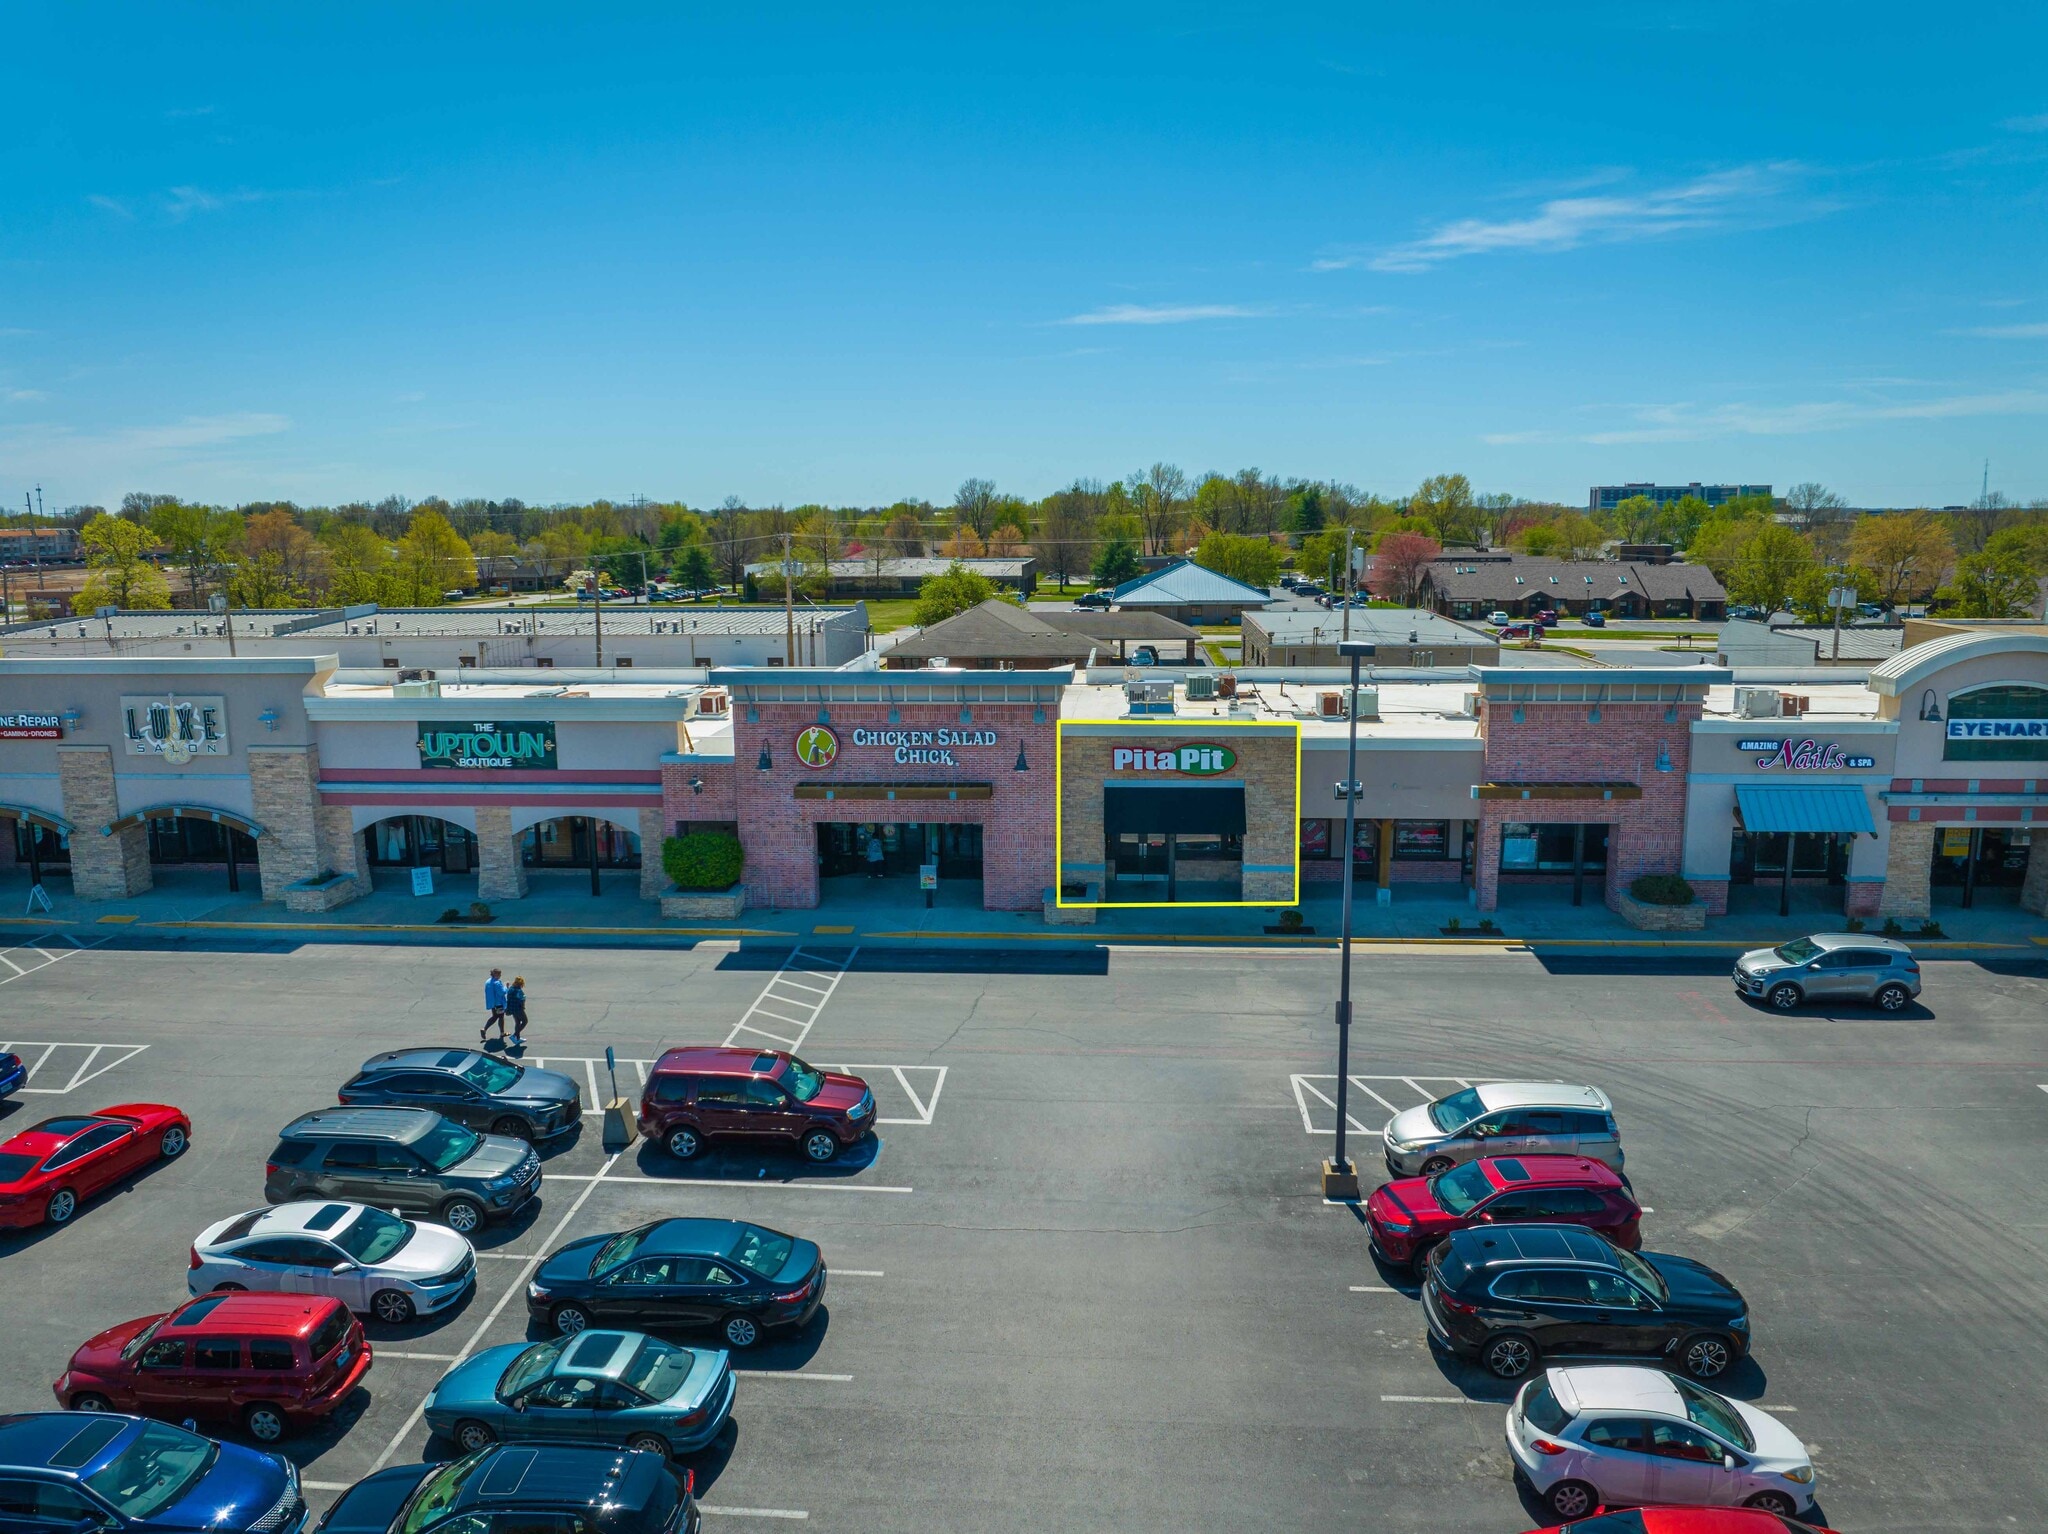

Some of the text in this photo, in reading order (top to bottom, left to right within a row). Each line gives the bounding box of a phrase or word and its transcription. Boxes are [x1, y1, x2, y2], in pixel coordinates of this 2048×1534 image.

[19, 714, 59, 727] REPAIR
[127, 707, 218, 740] LUXE
[473, 723, 494, 732] THE
[424, 732, 545, 758] UPTOWN
[853, 728, 996, 747] CHICKEN SALAD
[137, 743, 217, 753] SALON
[1741, 742, 1778, 750] AMAZING
[1758, 738, 1847, 769] Nails
[459, 757, 513, 767] BOUTIQUE
[894, 746, 953, 766] CHICK
